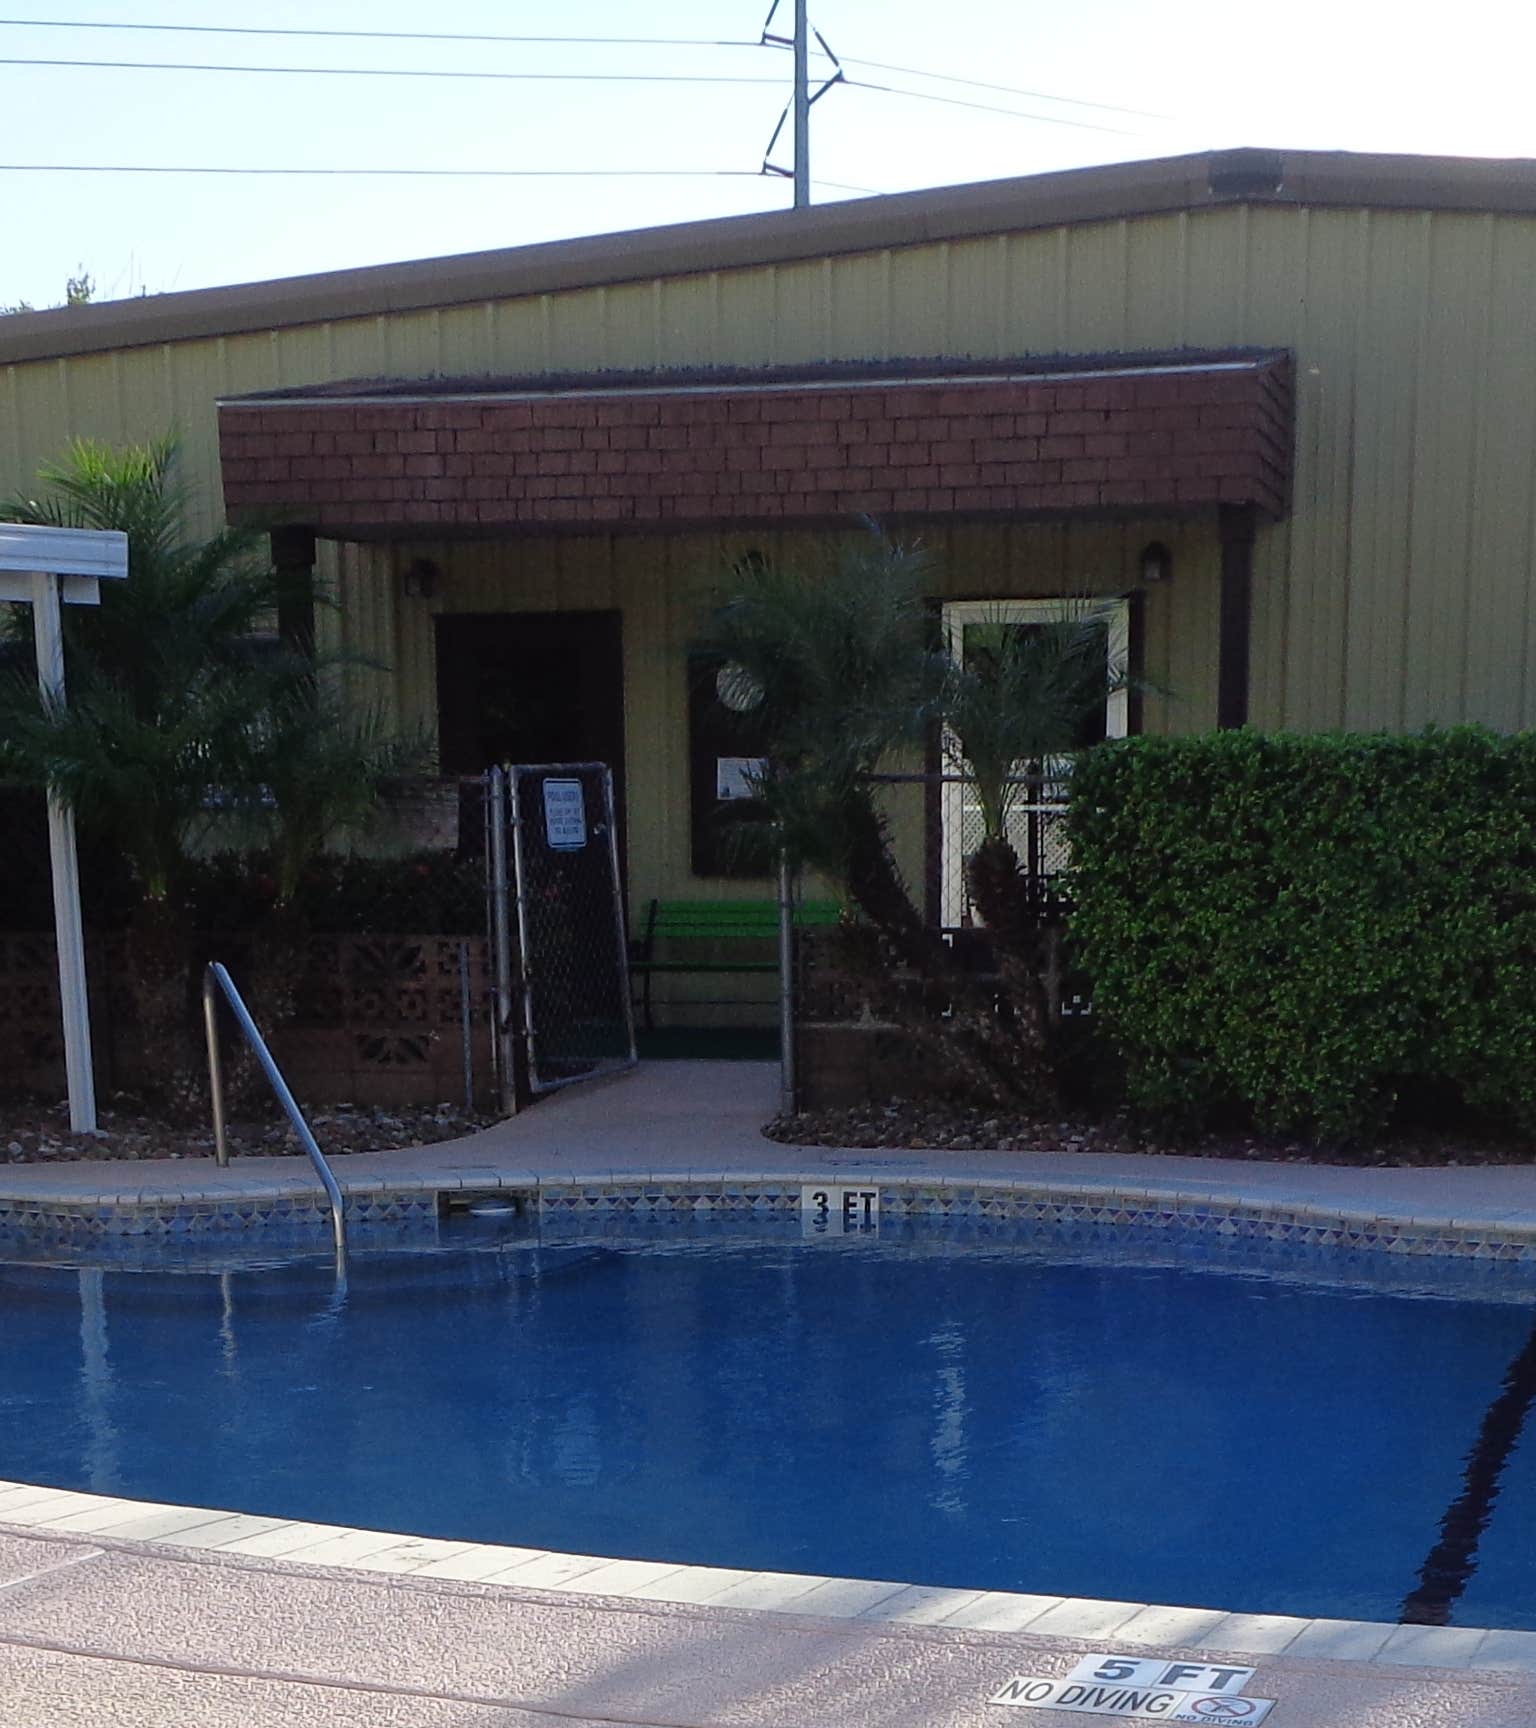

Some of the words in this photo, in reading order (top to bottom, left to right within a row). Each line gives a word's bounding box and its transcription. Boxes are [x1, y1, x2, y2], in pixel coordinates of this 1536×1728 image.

[812, 1191, 830, 1225] 3
[843, 1191, 876, 1228] FT
[1093, 1659, 1141, 1681] 5
[1159, 1664, 1249, 1691] FT
[999, 1680, 1054, 1702] NO
[1055, 1685, 1175, 1714] DIVING
[1175, 1713, 1197, 1722] NO
[1202, 1717, 1254, 1727] DIVING
